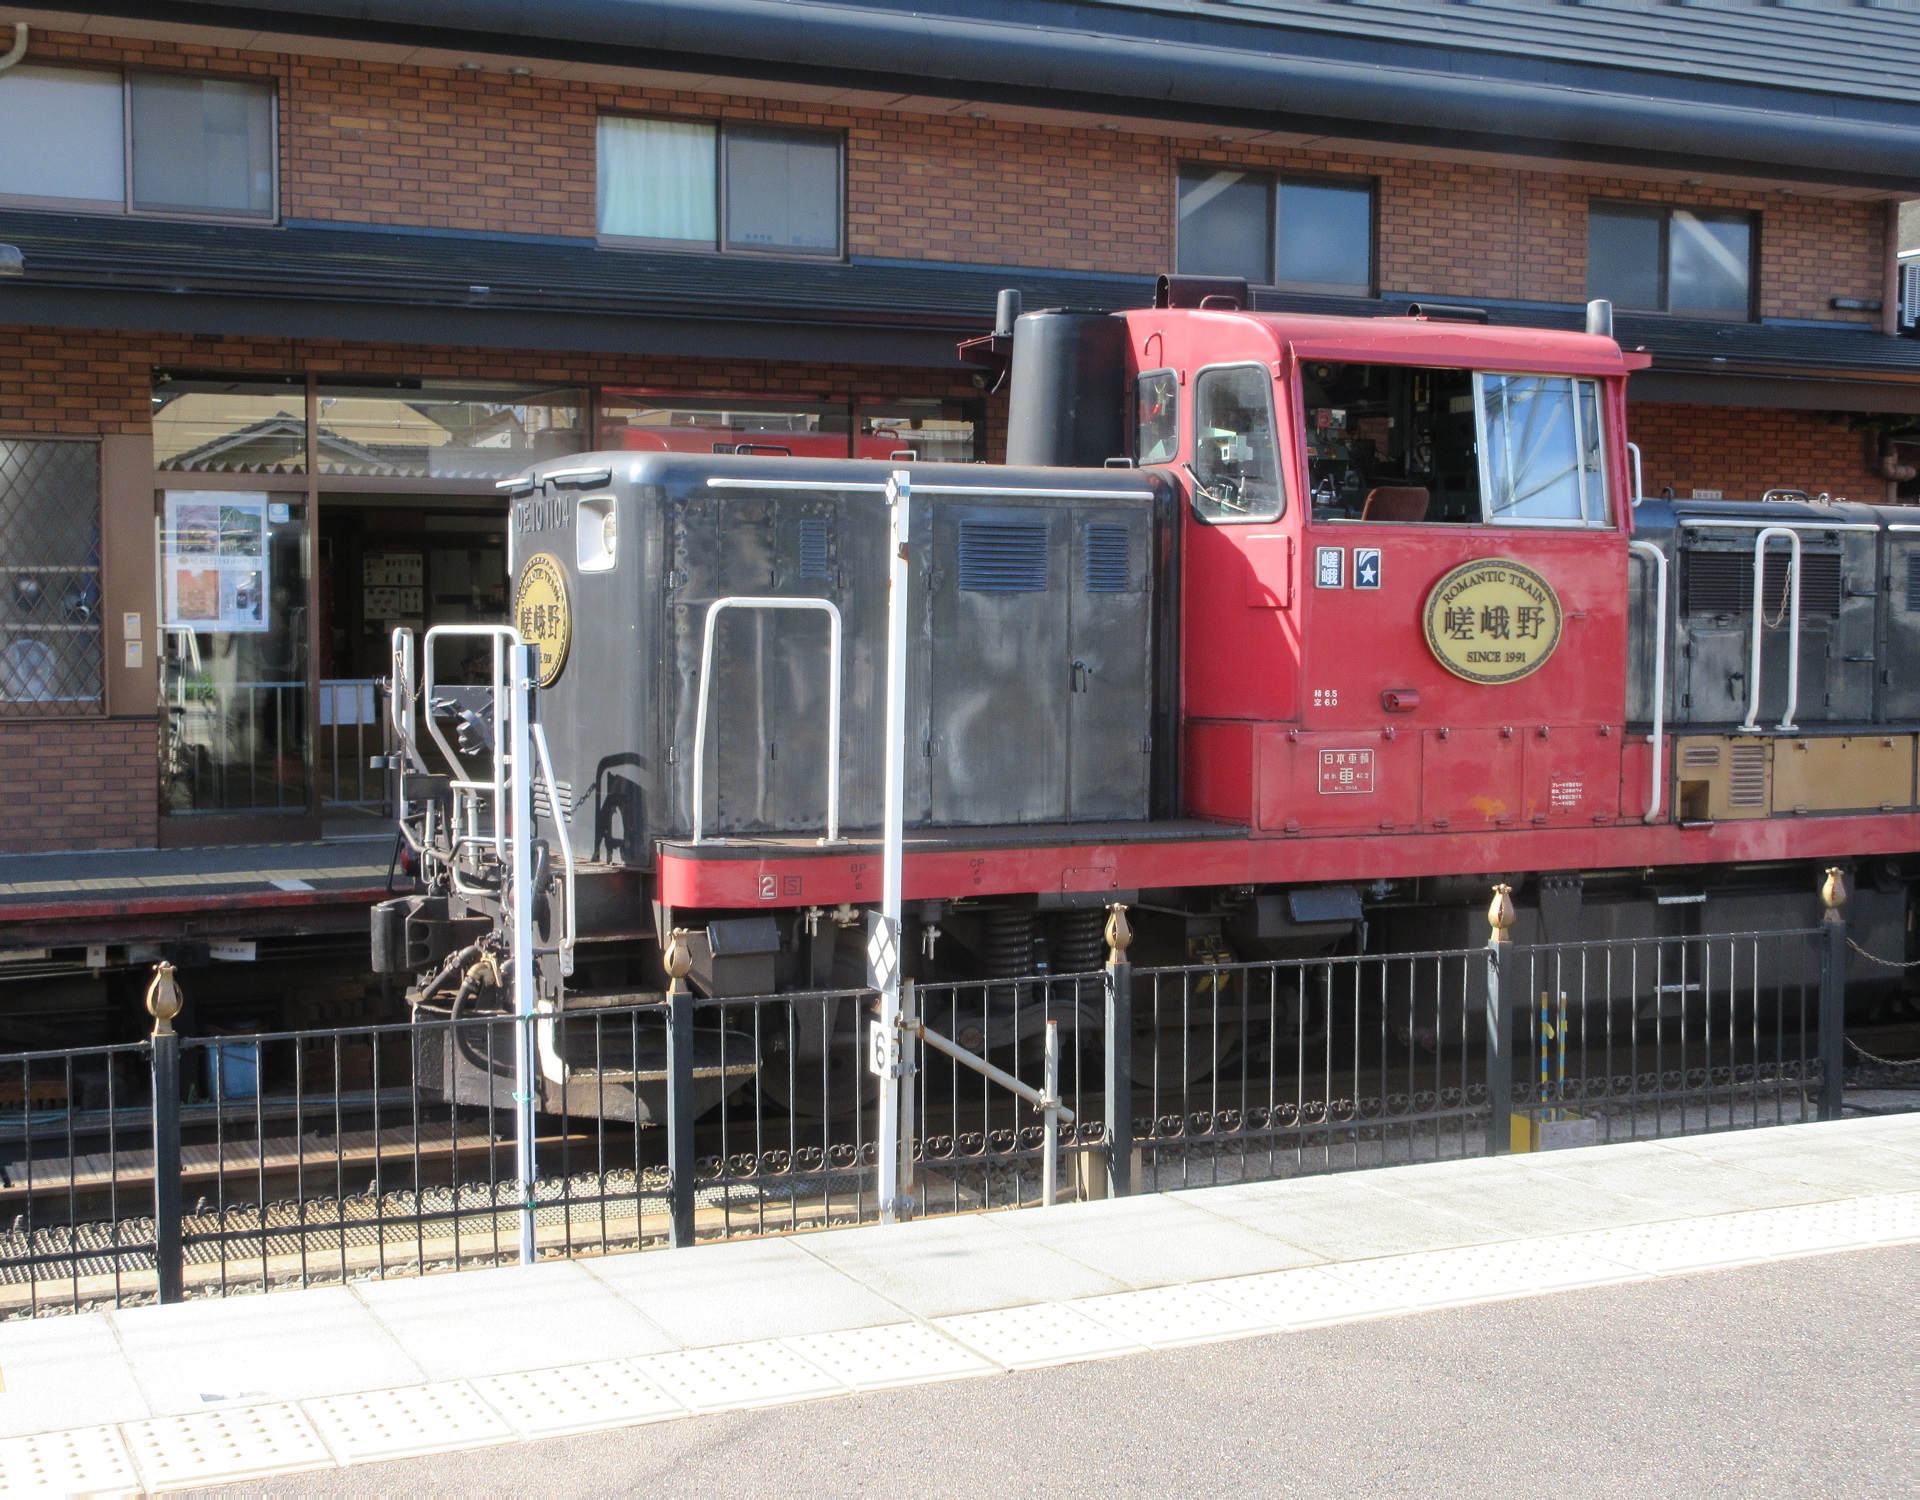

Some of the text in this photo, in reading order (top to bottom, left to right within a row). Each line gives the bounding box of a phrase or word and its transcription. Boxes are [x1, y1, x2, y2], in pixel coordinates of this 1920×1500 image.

[1442, 571, 1546, 605] ROMANTIC TRAIN
[520, 604, 560, 640] 嵯峨野
[1444, 605, 1546, 640] 嵯峨野
[1466, 651, 1526, 663] SINCE 1991
[1324, 690, 1338, 698] 6.5
[1324, 698, 1338, 707] 6.0
[761, 876, 775, 897] 2
[786, 879, 797, 893] S
[876, 1031, 886, 1070] 6
